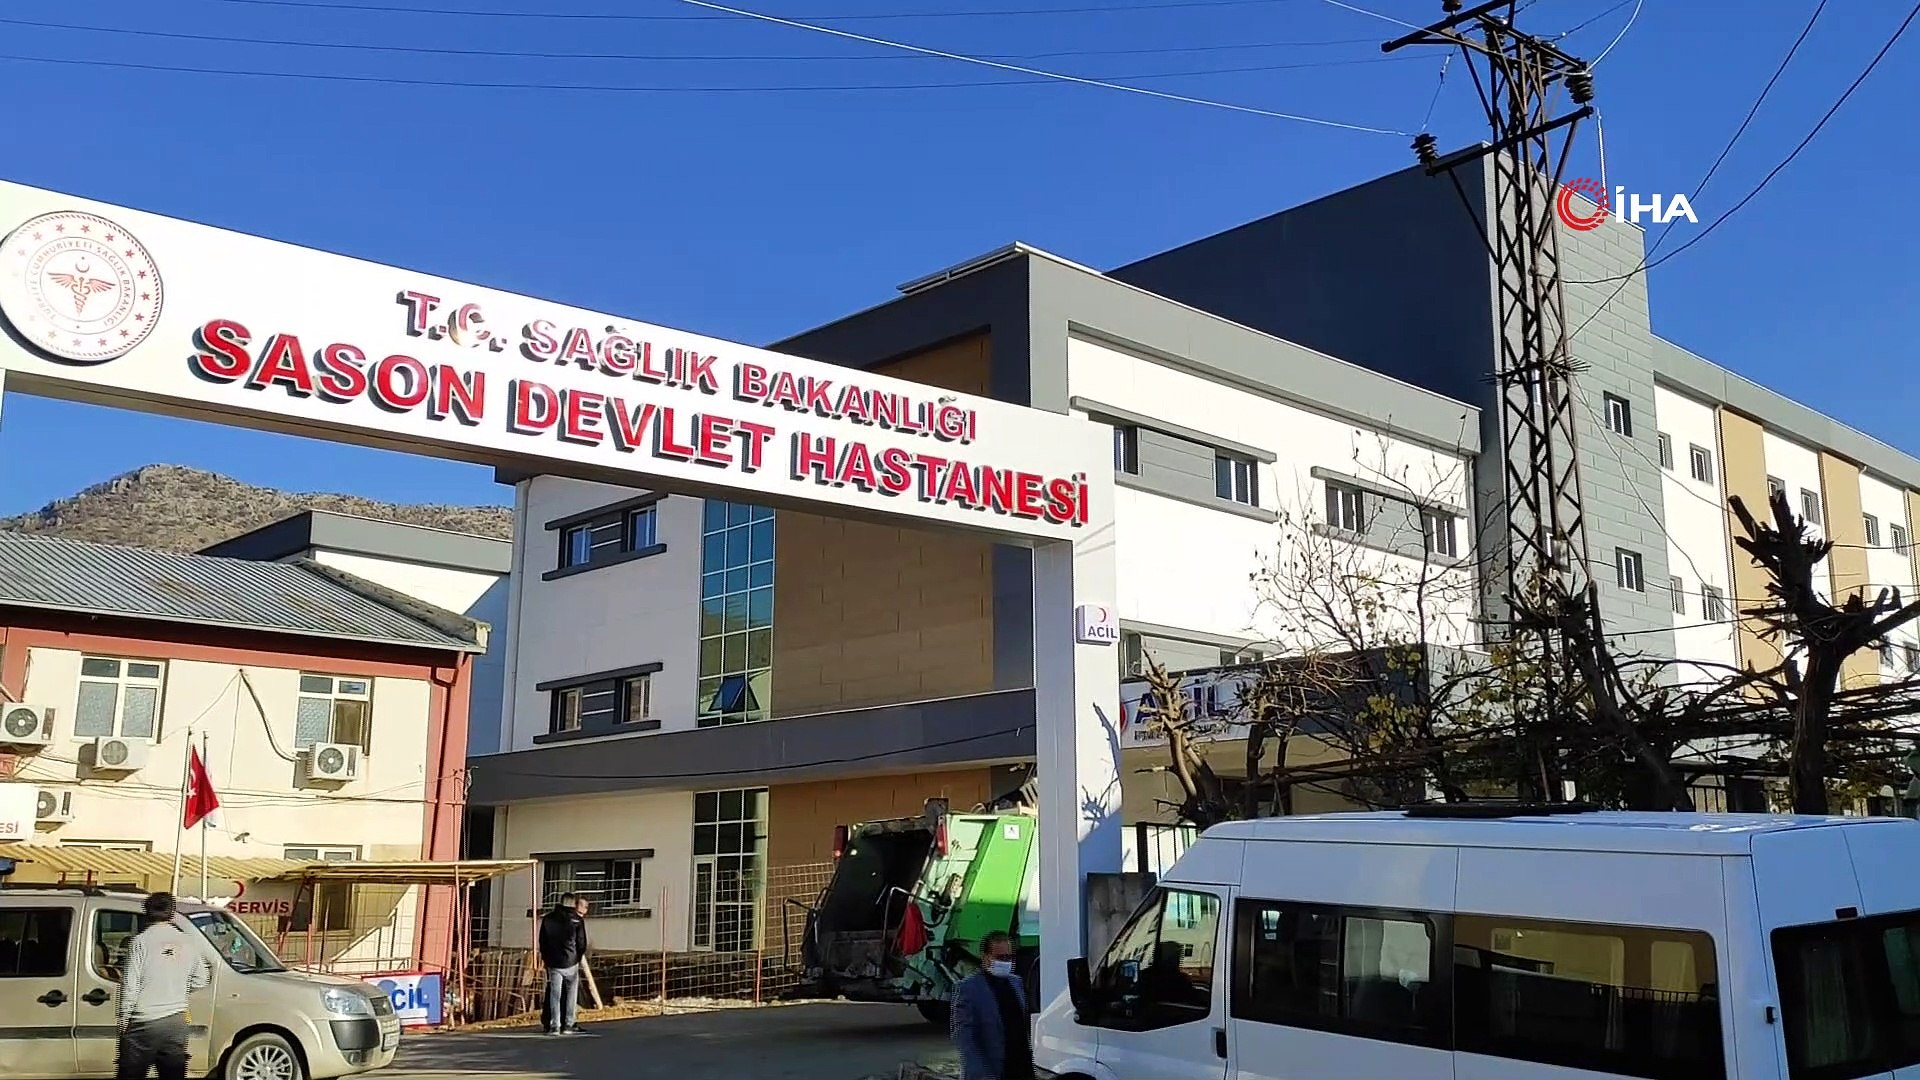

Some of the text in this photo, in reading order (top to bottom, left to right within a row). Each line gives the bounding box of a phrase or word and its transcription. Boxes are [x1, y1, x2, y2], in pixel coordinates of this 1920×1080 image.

[189, 318, 1089, 527] SASON DEVLET HASTANESİ
[397, 289, 976, 444] T.C. SAĞLIK BAKANLIĞI
[1088, 624, 1118, 639] ACİL
